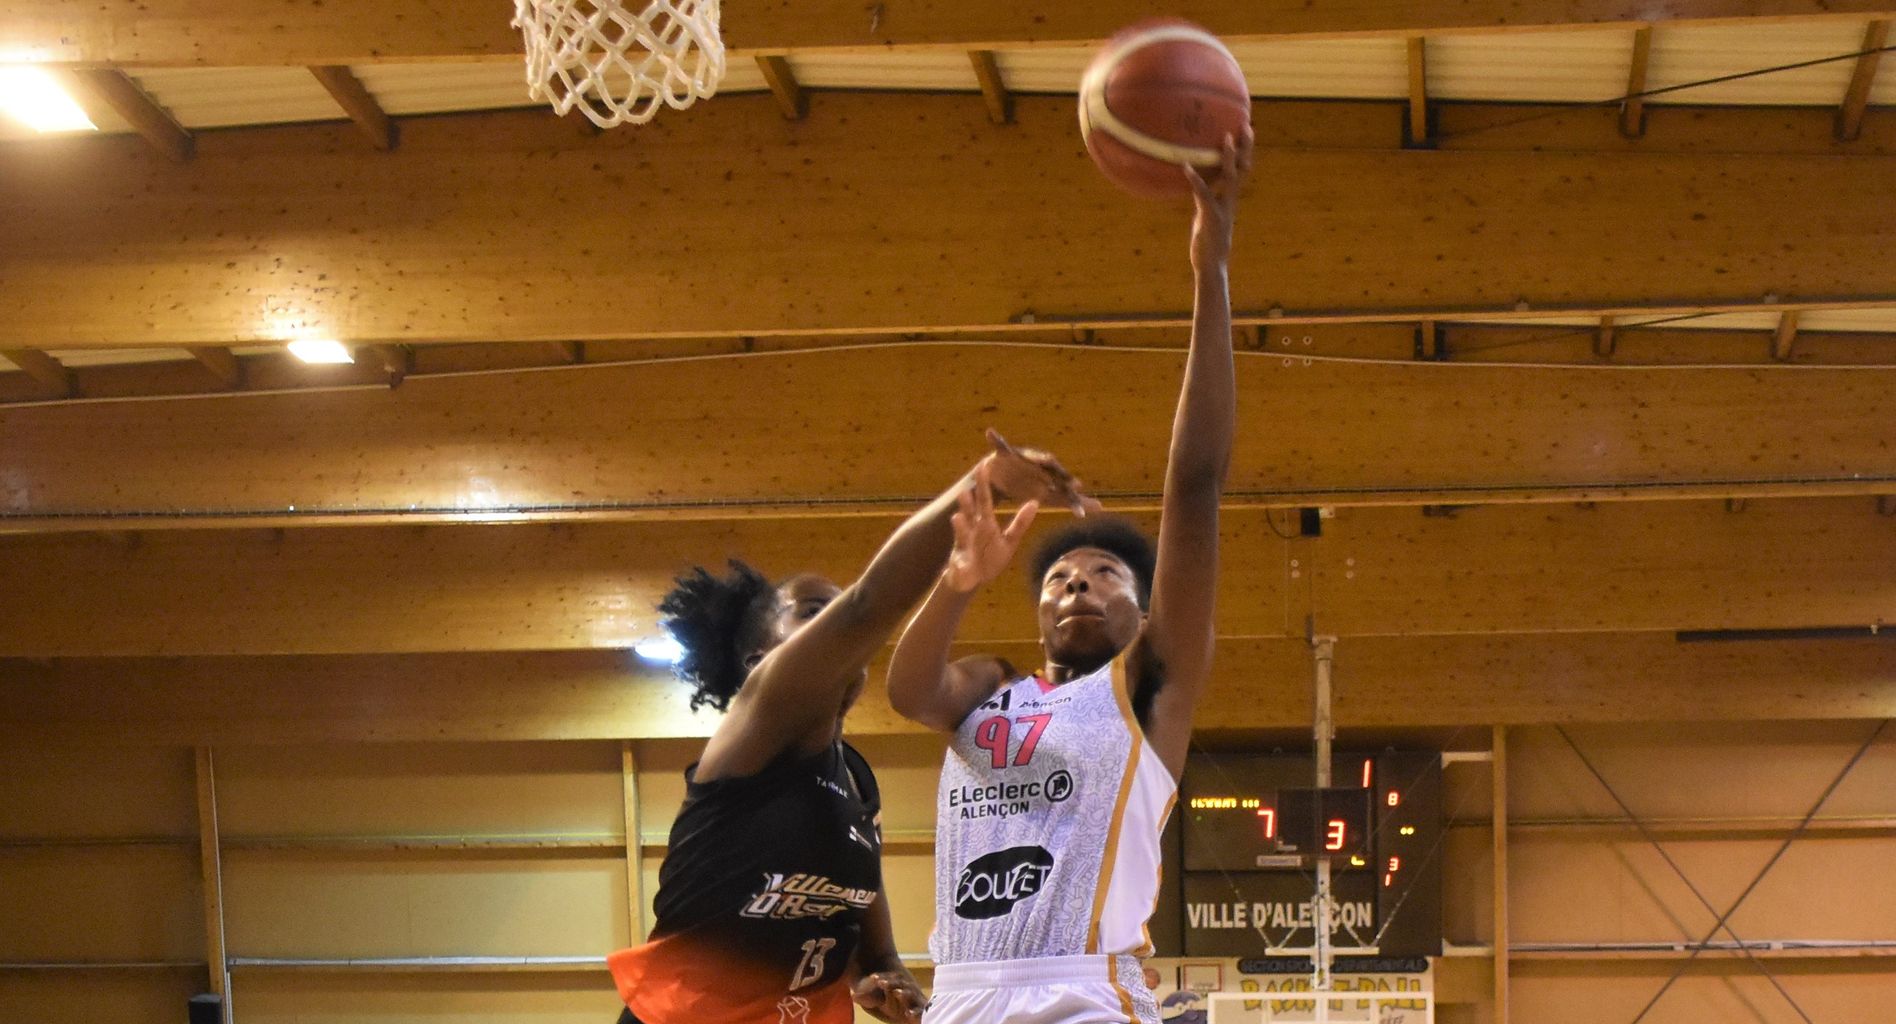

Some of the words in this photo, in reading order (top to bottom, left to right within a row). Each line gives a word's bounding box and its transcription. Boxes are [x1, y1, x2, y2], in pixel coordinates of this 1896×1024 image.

[975, 713, 1053, 769] 97
[960, 800, 1030, 820] ALENÇON
[1388, 792, 1399, 806] 8
[1257, 809, 1274, 838] 7
[1325, 821, 1344, 850] 3
[1187, 903, 1248, 929] VILLE
